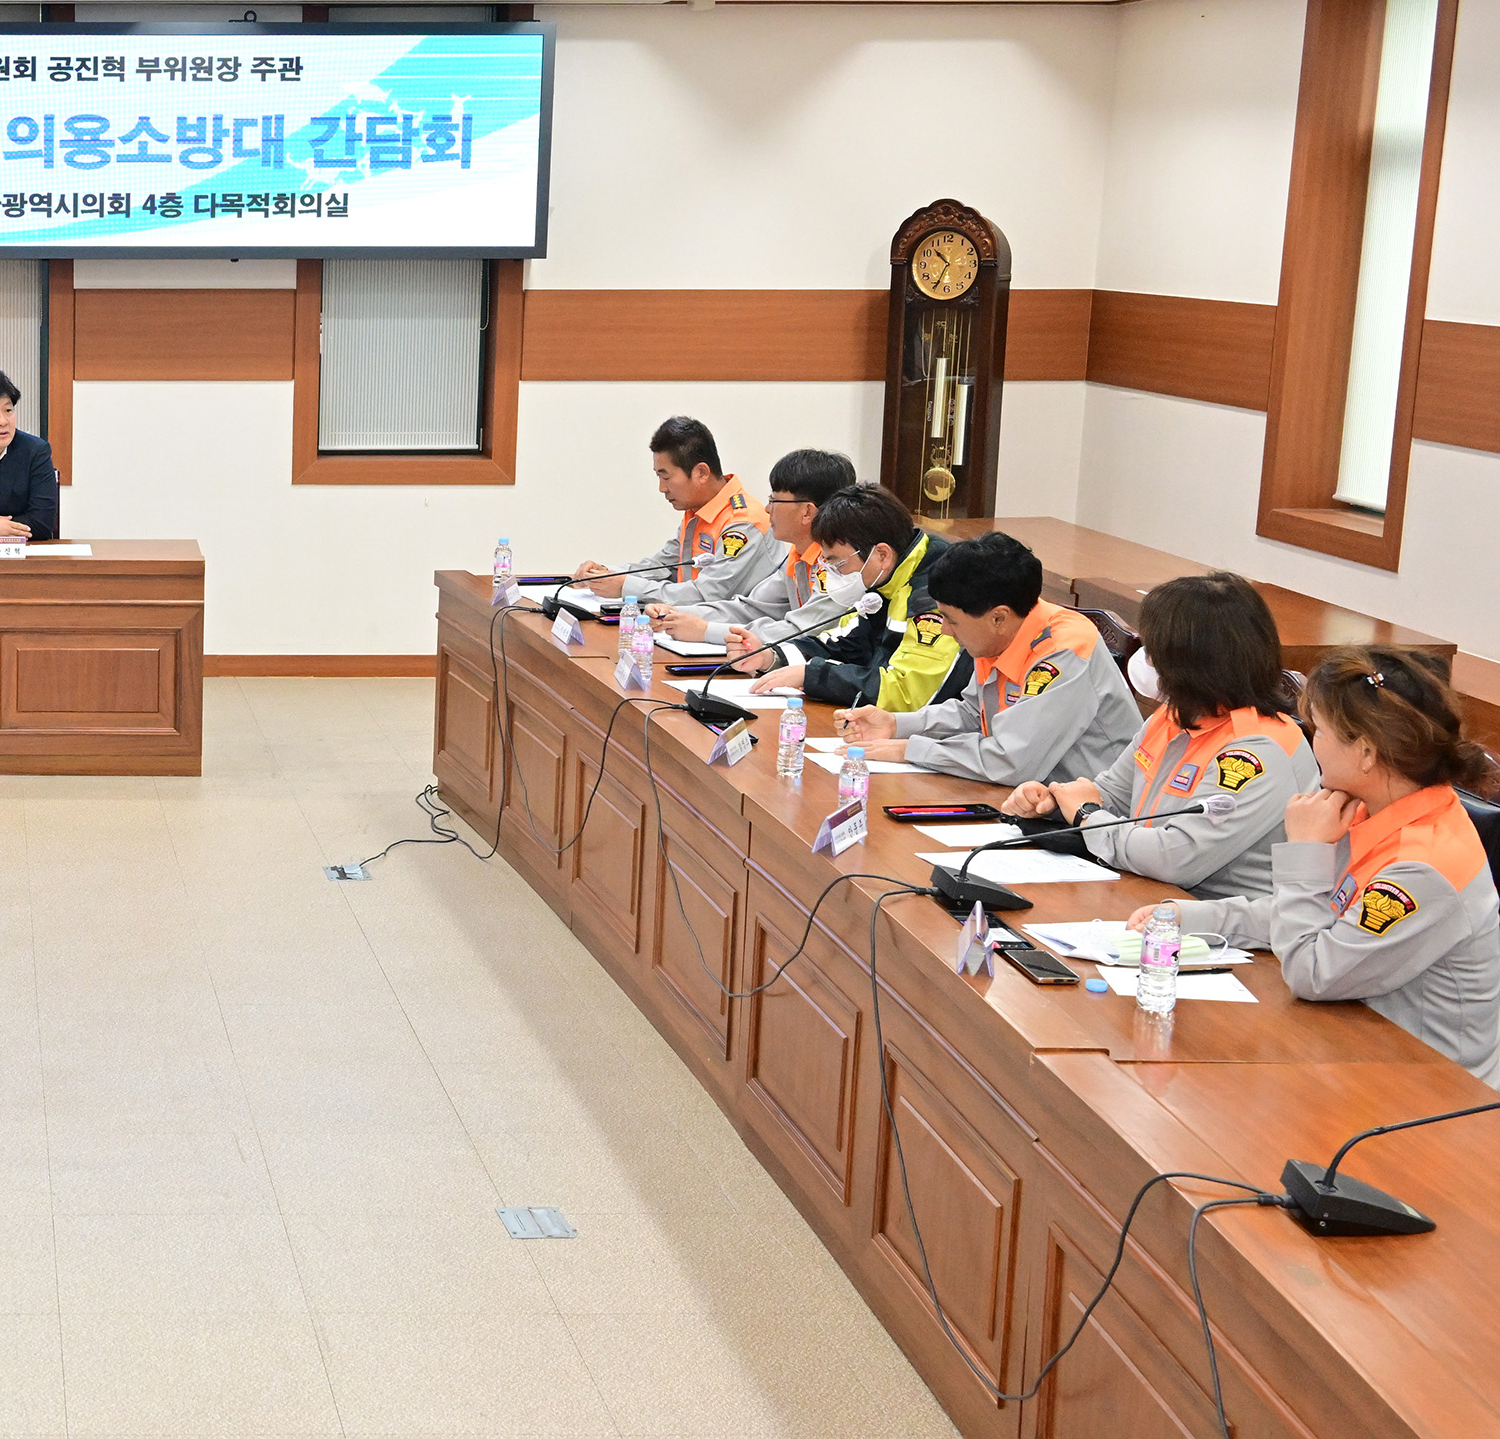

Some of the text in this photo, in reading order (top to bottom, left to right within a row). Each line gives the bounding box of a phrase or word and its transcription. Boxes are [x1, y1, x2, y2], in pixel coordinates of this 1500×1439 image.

[47, 56, 125, 82] 공진혁
[136, 56, 242, 82] 부위원장
[250, 56, 304, 82] 주관
[3, 114, 285, 169] 의용소방대
[307, 114, 473, 169] 간담회
[142, 192, 184, 219] 4층
[194, 192, 349, 219] 다목적회의실
[932, 238, 940, 247] 11
[943, 234, 954, 243] 12
[923, 249, 932, 257] 10
[967, 247, 974, 256] 2
[919, 261, 927, 269] 9
[969, 259, 977, 268] 3
[922, 272, 930, 280] 8
[964, 271, 972, 279] 4
[943, 285, 951, 293] 6
[956, 281, 964, 290] 5
